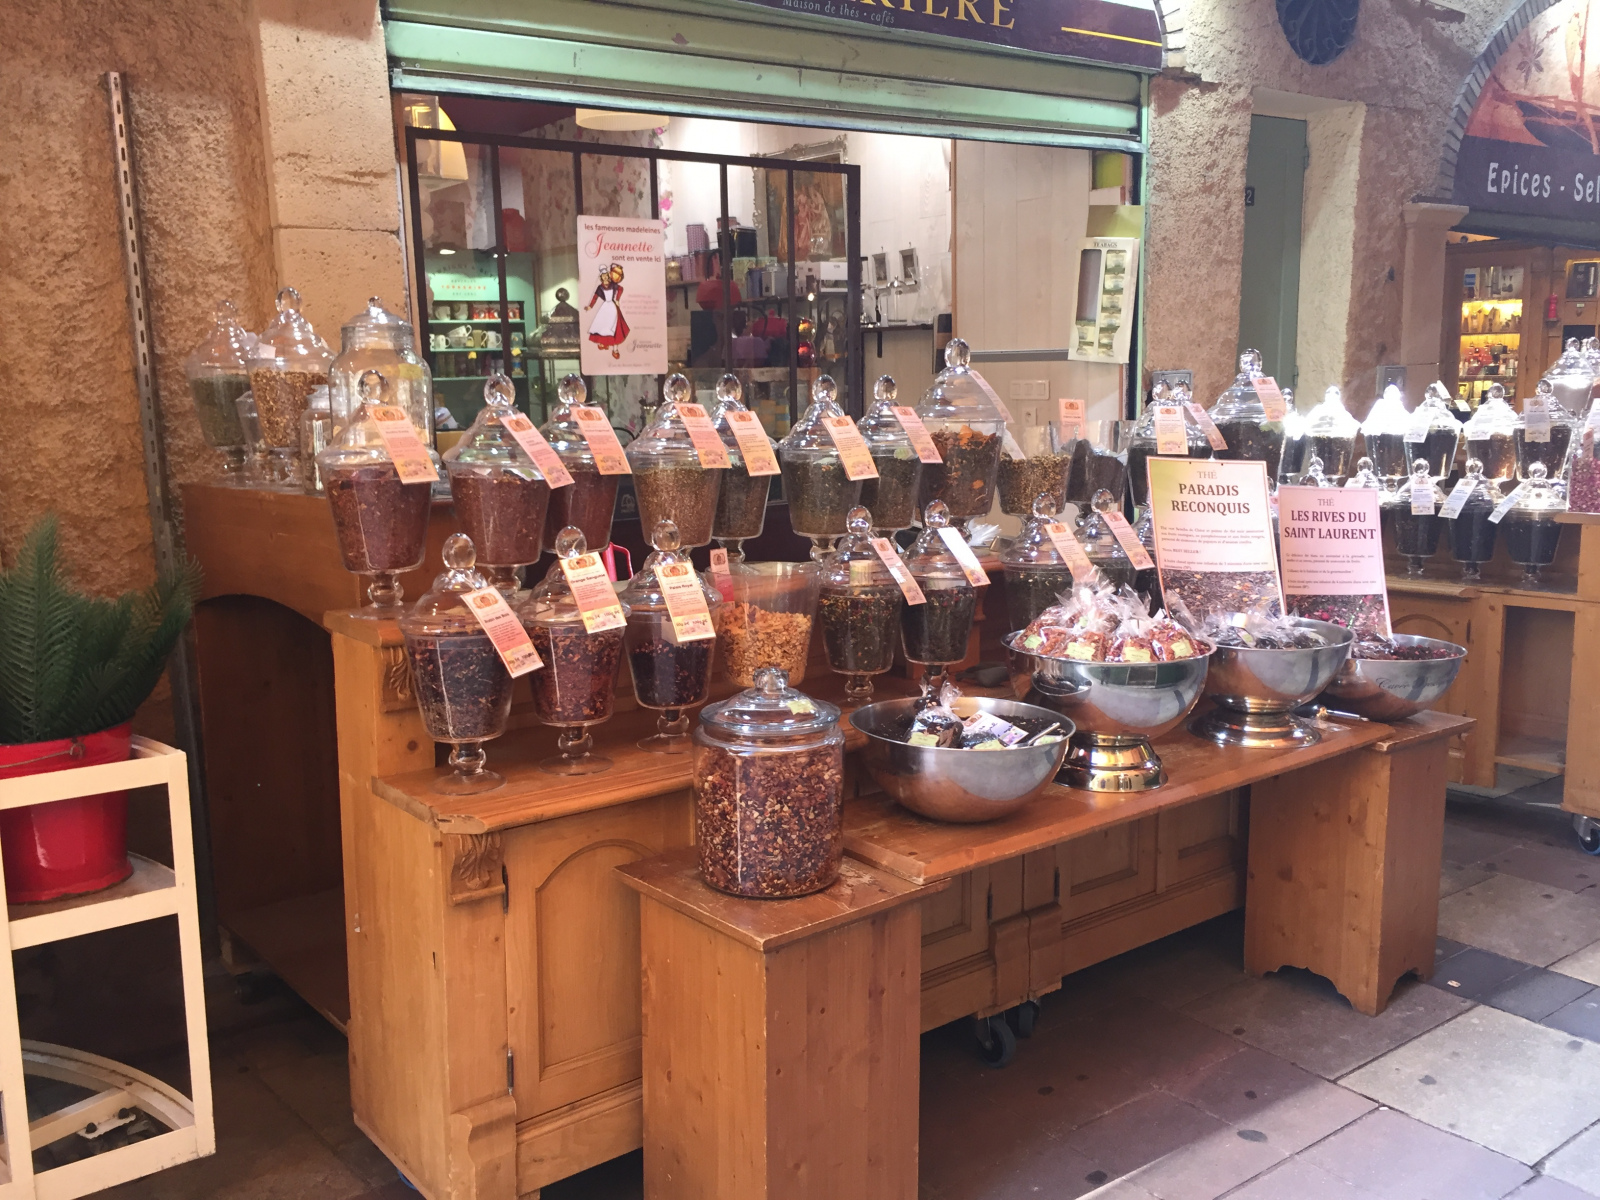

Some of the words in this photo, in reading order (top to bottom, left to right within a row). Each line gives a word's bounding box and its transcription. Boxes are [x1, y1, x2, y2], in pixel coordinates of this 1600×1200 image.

[824, 1, 836, 13] de
[840, 4, 859, 18] thés
[870, 10, 895, 26] cafés
[1487, 162, 1551, 198] Epices
[1246, 189, 1252, 203] 2
[584, 223, 594, 231] les
[595, 224, 625, 232] fameuses
[626, 226, 661, 234] madeleines
[585, 233, 654, 259] Jeannette
[1197, 470, 1217, 479] THÉ
[1179, 483, 1239, 496] PARADIS
[1171, 500, 1250, 516] RECONQUIS
[1317, 497, 1334, 506] THÉ
[1291, 510, 1309, 521] LES
[1312, 511, 1345, 522] RIVES
[1348, 512, 1366, 523] DU
[1284, 527, 1315, 538] SAINT
[1318, 528, 1377, 540] LAURENT
